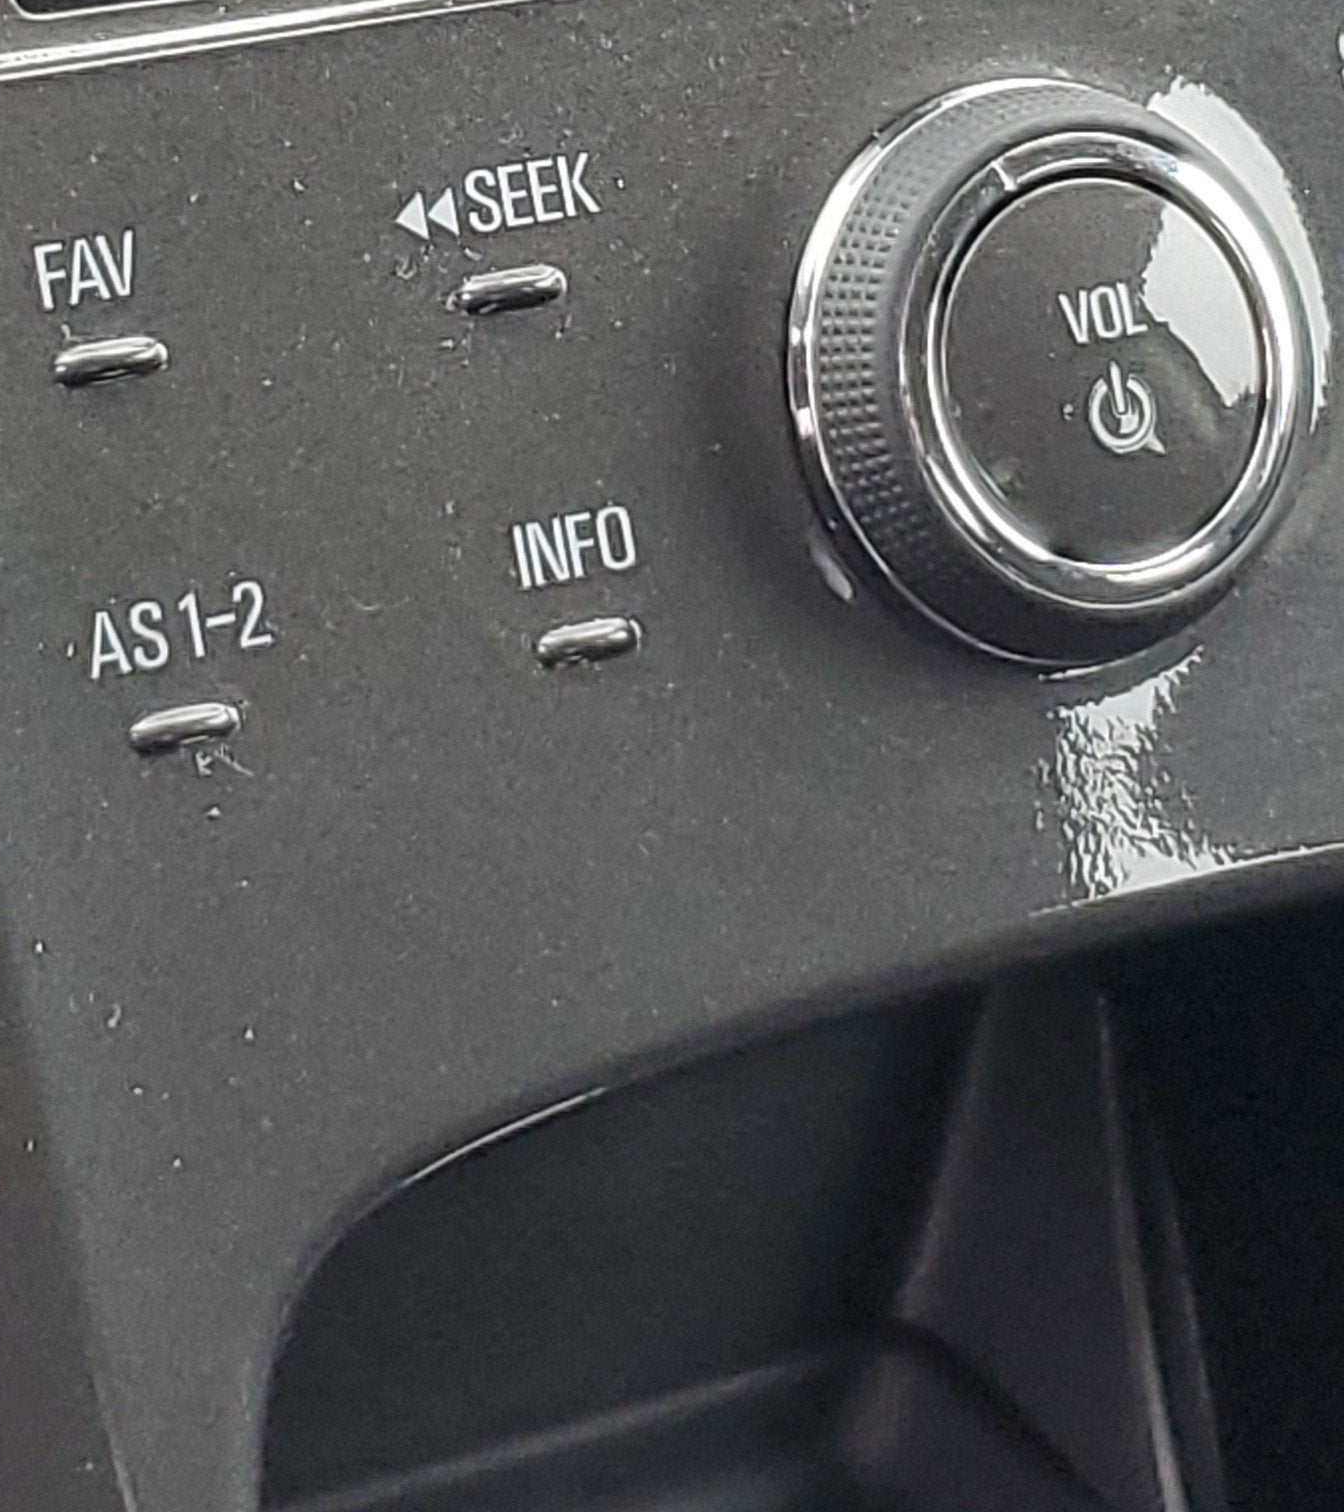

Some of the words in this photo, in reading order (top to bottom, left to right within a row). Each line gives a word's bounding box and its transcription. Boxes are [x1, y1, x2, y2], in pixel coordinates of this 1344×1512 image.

[462, 154, 601, 236] SEEK
[32, 231, 136, 311] FAV
[1058, 282, 1148, 345] VOL
[511, 505, 636, 590] INFO
